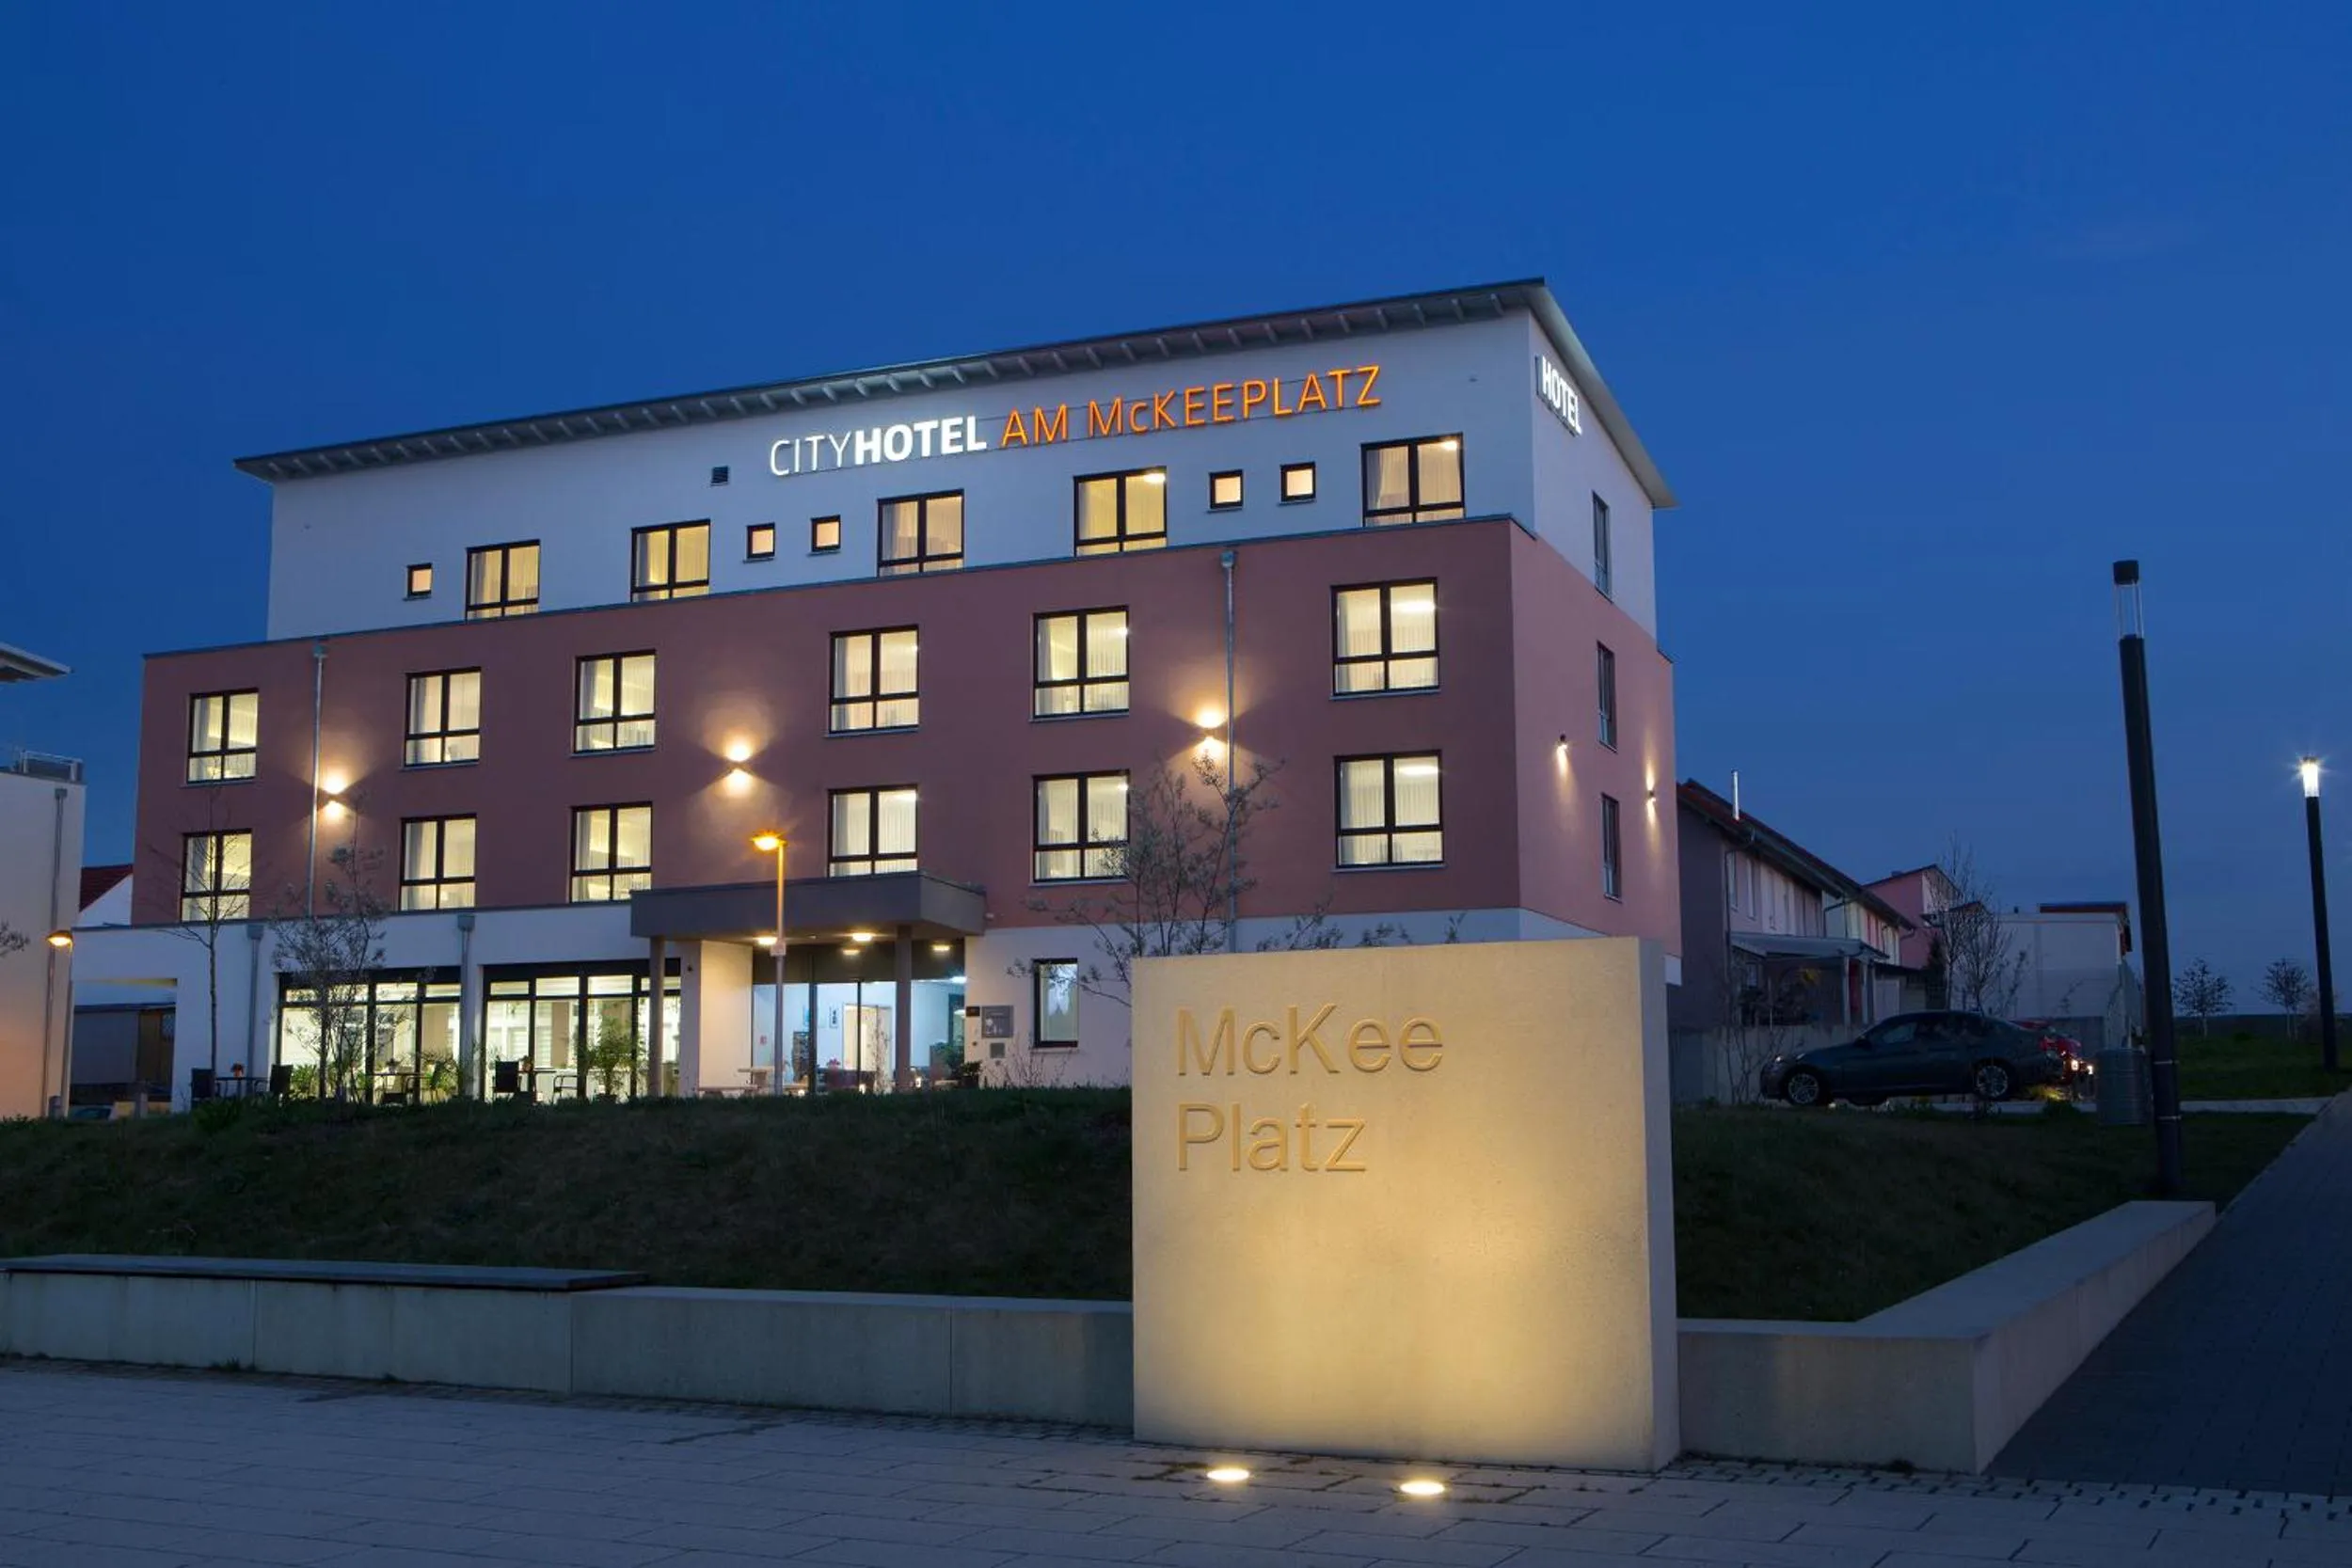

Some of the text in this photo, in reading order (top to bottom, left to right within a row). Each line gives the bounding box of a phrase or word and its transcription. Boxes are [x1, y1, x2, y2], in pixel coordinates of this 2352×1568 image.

[1001, 404, 1068, 448] AM
[1088, 364, 1381, 437] McKEEPLATZ
[1542, 356, 1582, 435] HOTEL
[1177, 1003, 1443, 1076] McKee
[1178, 1101, 1367, 1172] Platz
